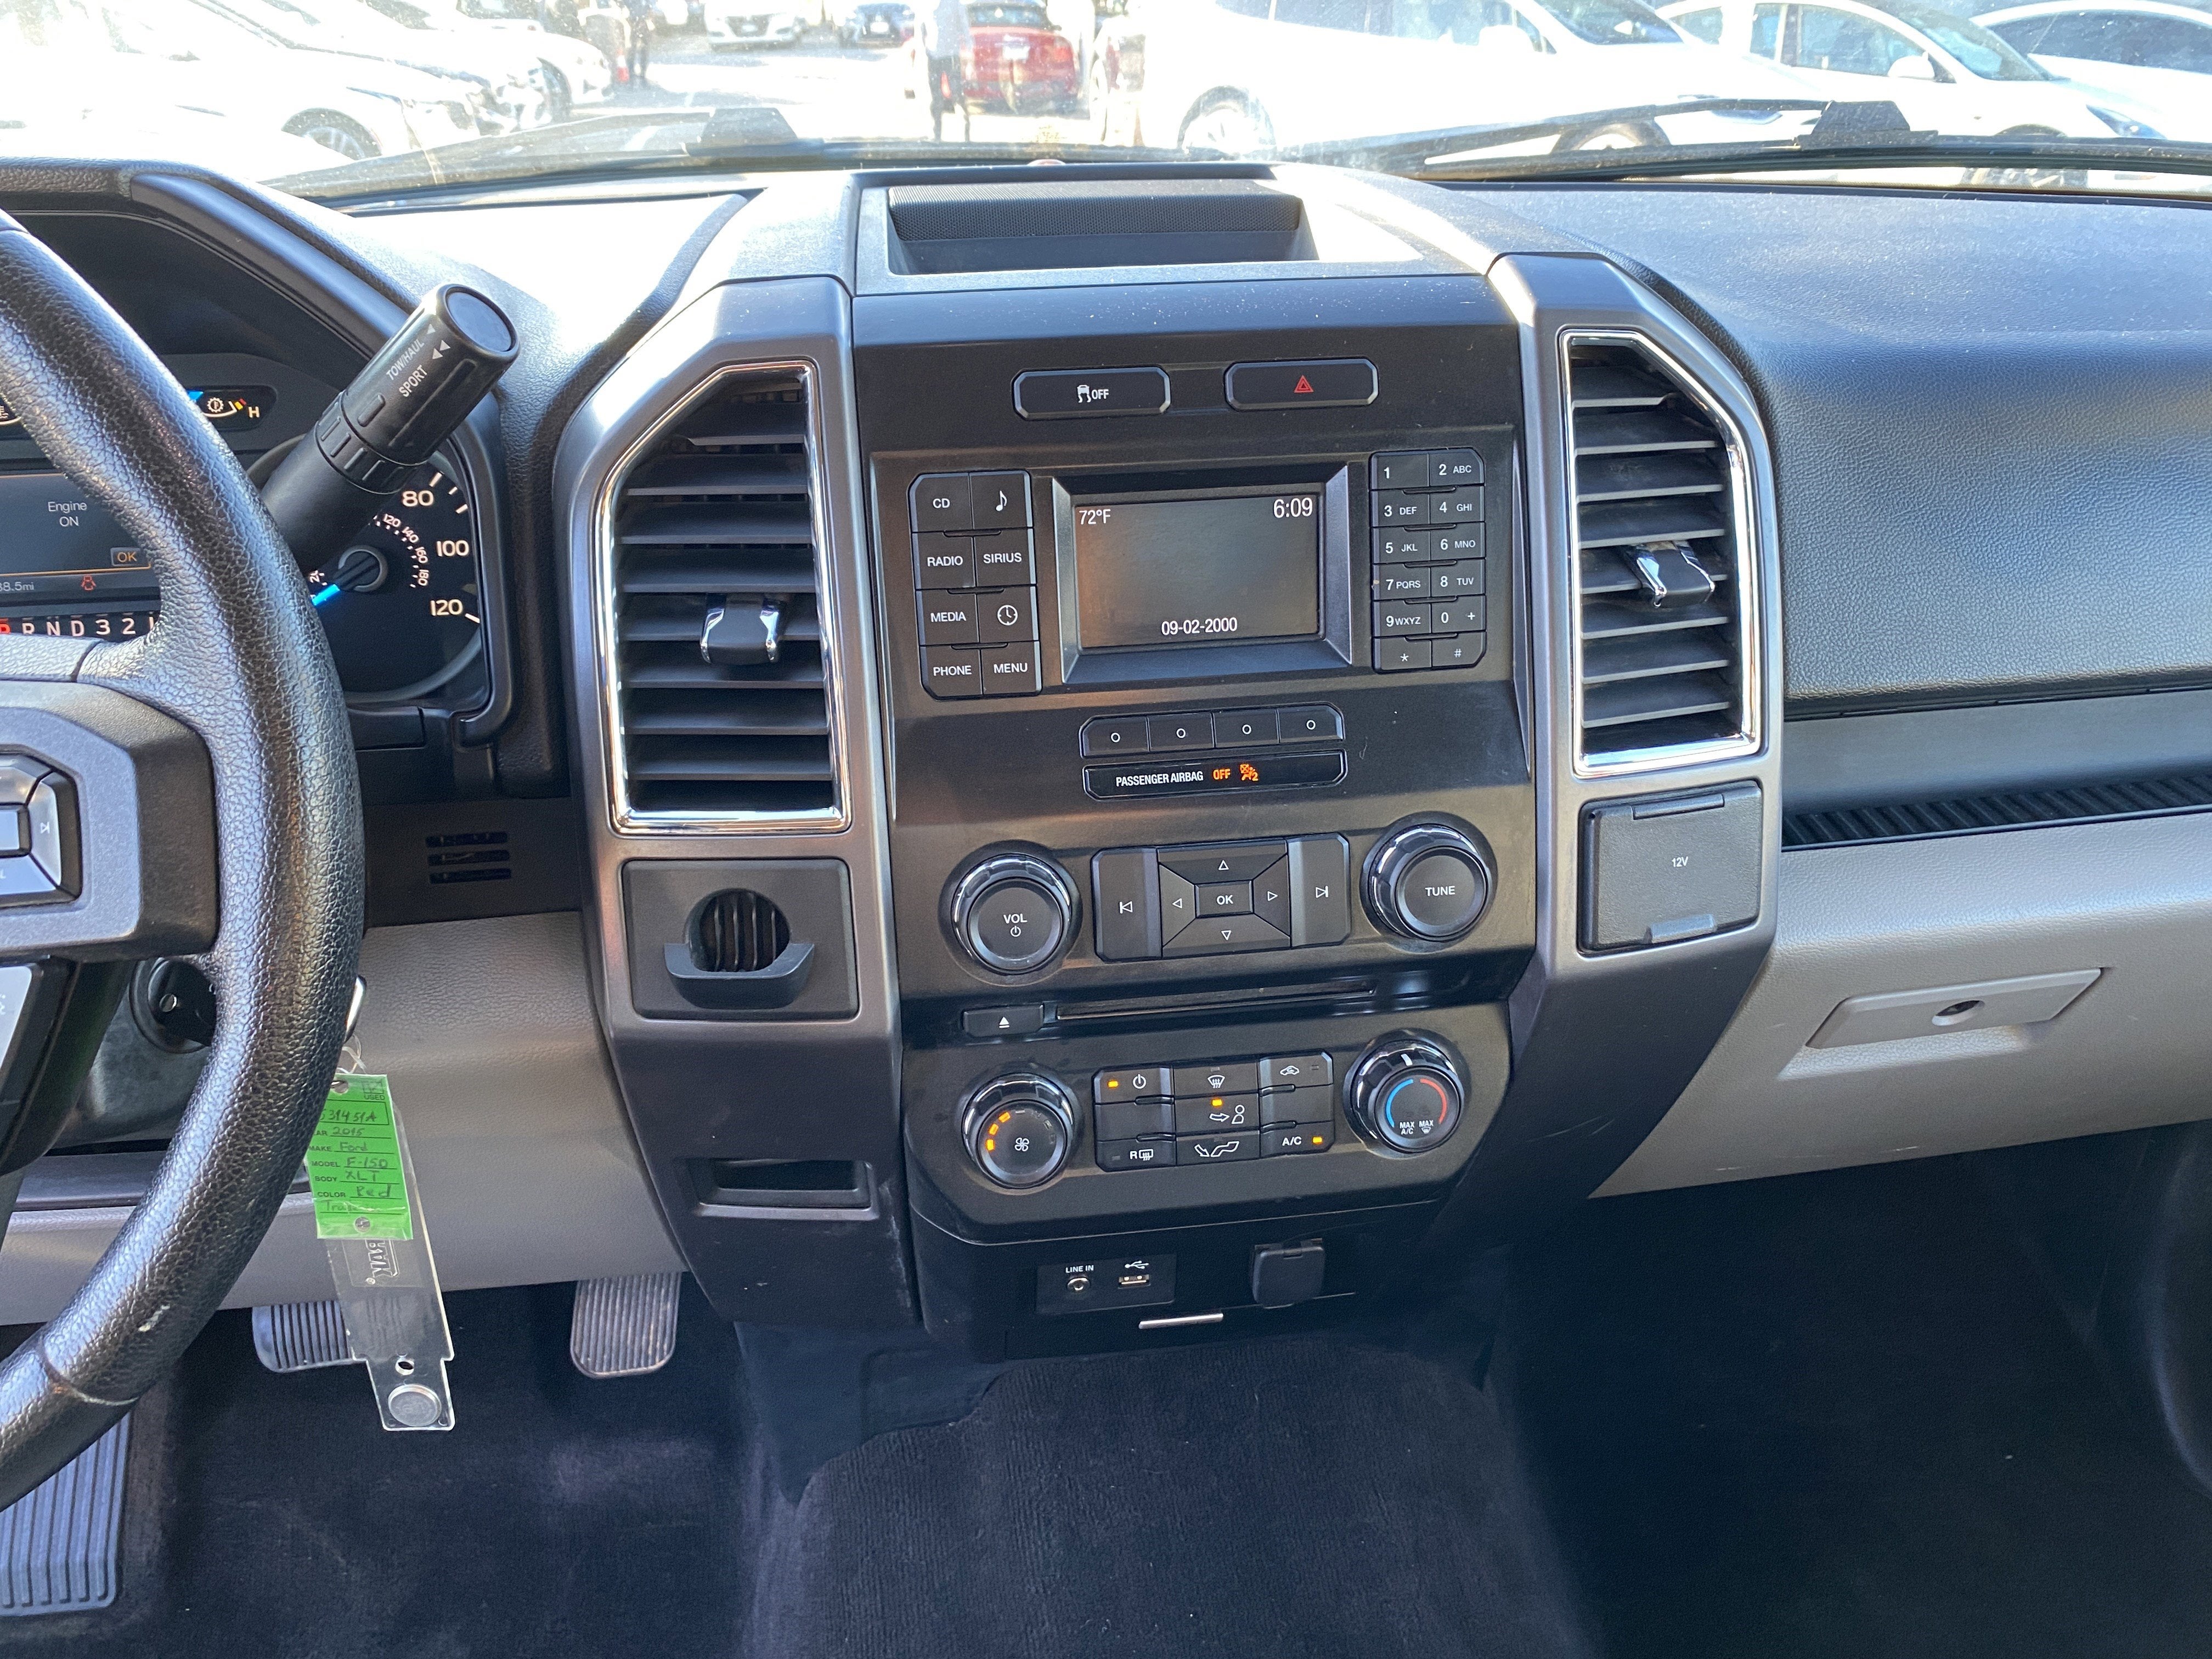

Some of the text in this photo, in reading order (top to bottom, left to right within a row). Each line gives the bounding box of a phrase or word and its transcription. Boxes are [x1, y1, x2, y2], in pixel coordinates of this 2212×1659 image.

[386, 339, 425, 380] TOW/HAUL
[398, 364, 427, 397] SPORT
[1091, 388, 1109, 400] OFF
[248, 406, 260, 418] H
[1384, 467, 1390, 478] 1
[1438, 464, 1472, 476] 2 ABC
[401, 490, 434, 507] 80
[932, 498, 950, 509] CD
[48, 501, 87, 514] Engine
[1272, 497, 1313, 518] 6:09
[1384, 505, 1417, 517] 3 DEF
[1439, 501, 1472, 513] 4 GHI
[59, 516, 80, 527] ON
[383, 513, 401, 527] 120
[1078, 508, 1111, 525] 72°F
[402, 526, 419, 544] 140
[436, 540, 470, 557] 100
[1385, 542, 1418, 554] 5 JKL
[1440, 538, 1476, 550] 6 MNO
[117, 551, 137, 563] OK
[415, 546, 428, 565] 160
[927, 555, 964, 567] RADIO
[983, 552, 1023, 564] SIRIUS
[417, 569, 430, 586] 180
[1440, 575, 1474, 588] 8 TUV
[1385, 579, 1421, 591] 7 PQRS
[430, 599, 464, 616] 120
[930, 611, 967, 623] MEDIA
[46, 621, 61, 636] N
[71, 620, 84, 636] D
[95, 619, 111, 635] 3
[121, 617, 136, 635] 2
[1160, 617, 1238, 636] 09-02-2000
[933, 665, 972, 677] PHONE
[993, 662, 1029, 674] MENU
[1115, 768, 1231, 788] PASSENGER AIRBAG OFF
[1672, 856, 1689, 867] 12V
[1424, 884, 1455, 897] TUNE
[1216, 894, 1234, 906] OK
[1003, 913, 1028, 924] VOL
[1399, 1121, 1415, 1129] MAX
[1419, 1120, 1434, 1128] MAX
[1401, 1127, 1414, 1135] A/C
[340, 1141, 368, 1152] Ford
[1282, 1136, 1302, 1146] A/C
[1129, 1150, 1137, 1160] R
[346, 1156, 388, 1169] F-150
[345, 1170, 380, 1182] XLT
[356, 1183, 392, 1198] Red
